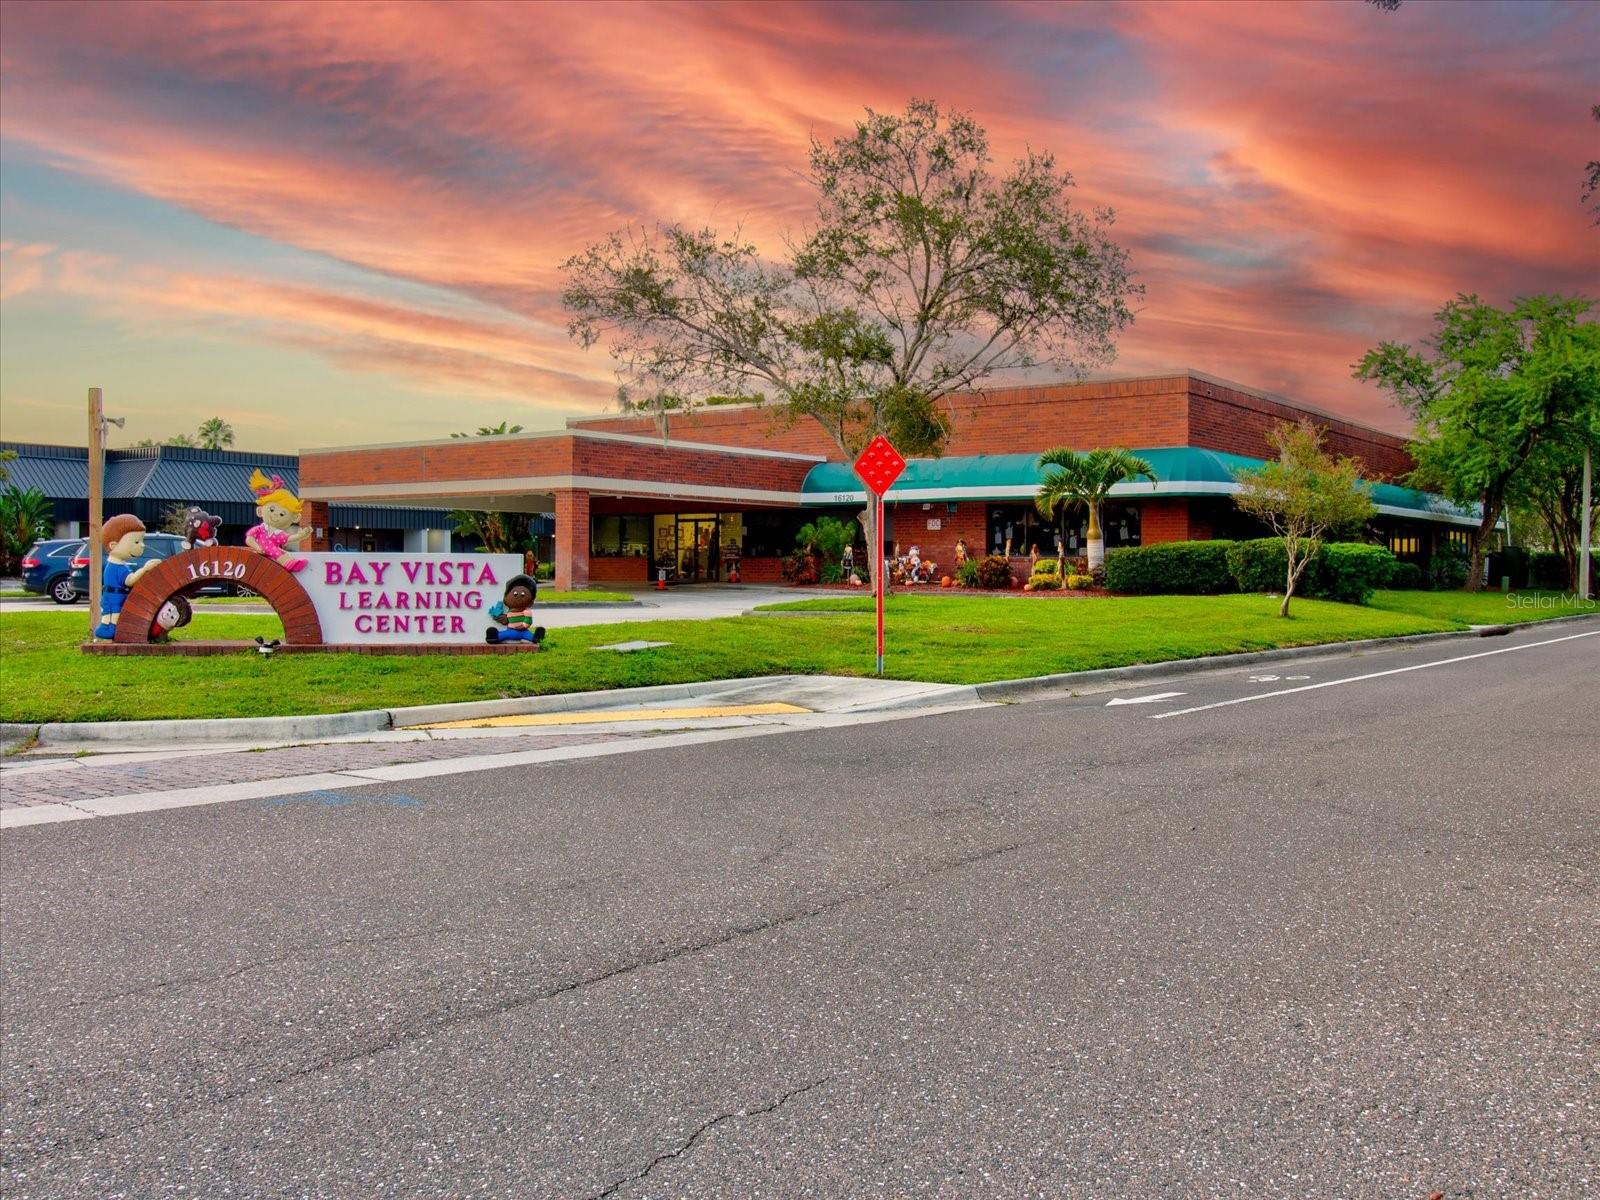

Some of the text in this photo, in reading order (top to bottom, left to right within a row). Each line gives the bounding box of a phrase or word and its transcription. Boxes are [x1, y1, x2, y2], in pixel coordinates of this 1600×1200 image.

[833, 494, 854, 502] 16120
[187, 560, 246, 580] 16120
[324, 561, 498, 586] BAY VISTA
[339, 590, 483, 610] LEARNING
[354, 614, 466, 634] CENTER
